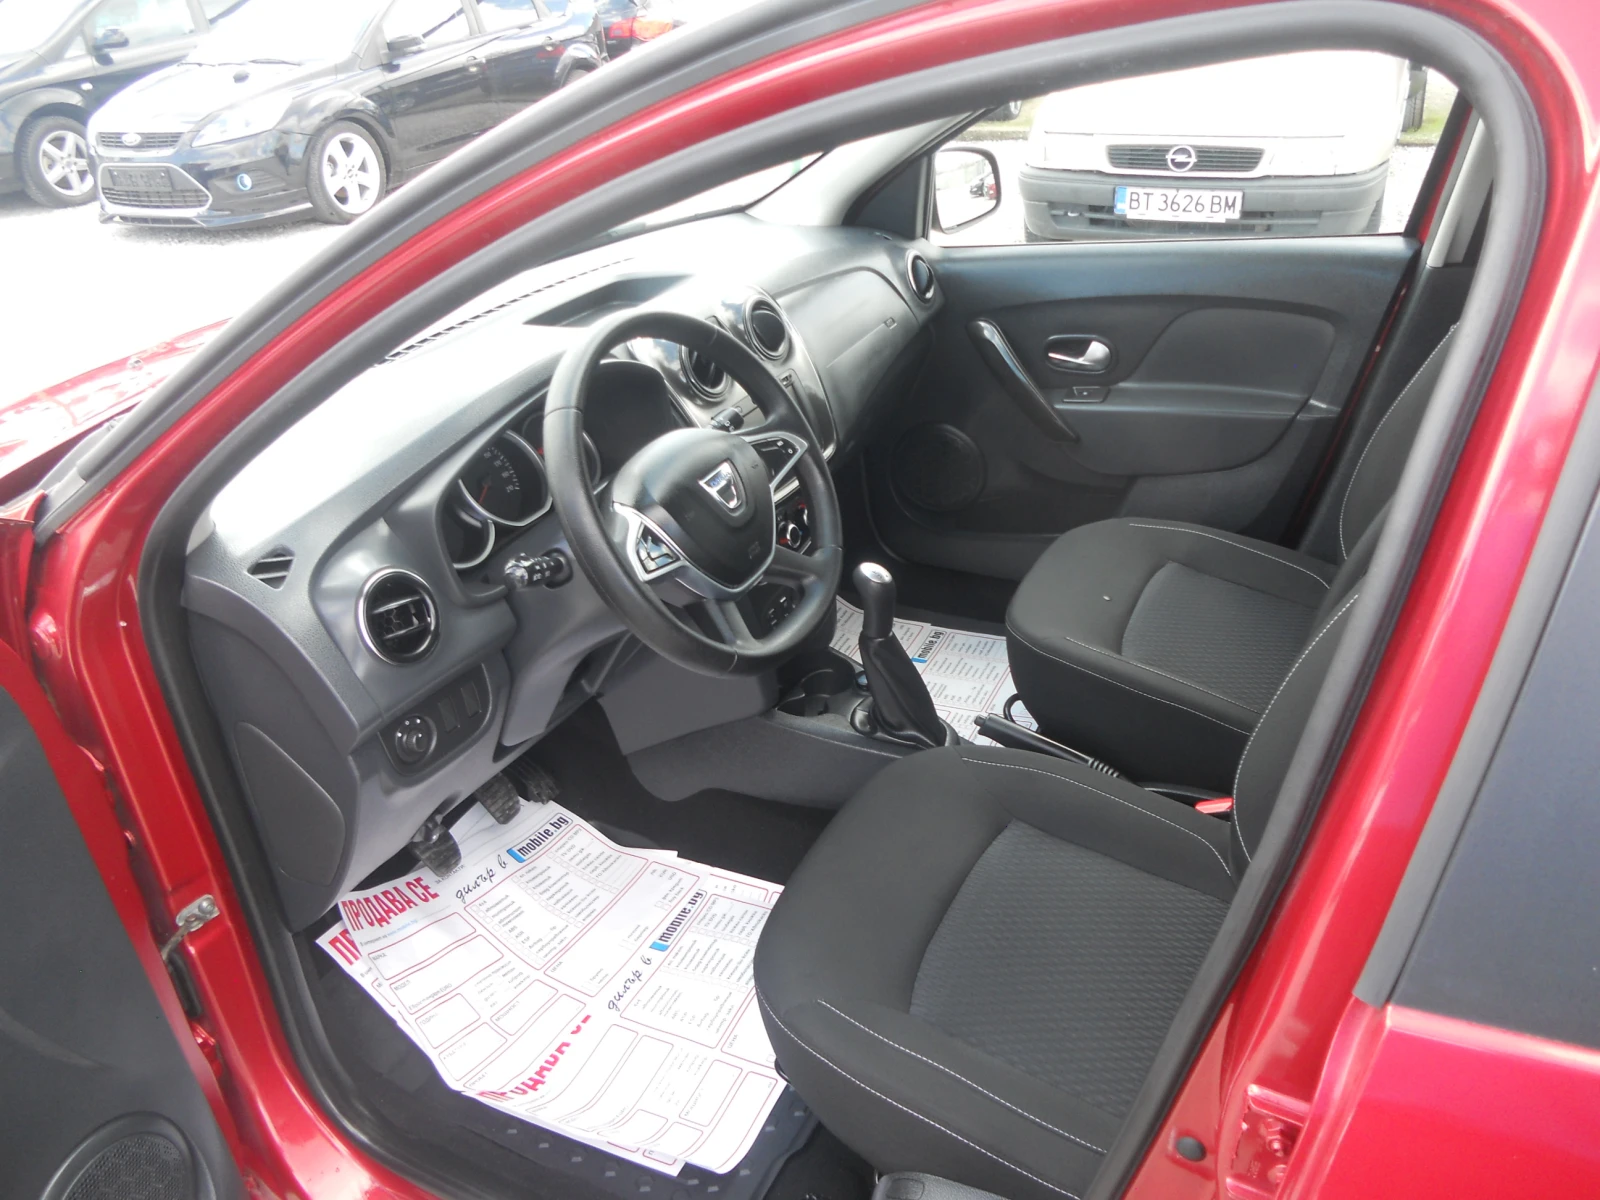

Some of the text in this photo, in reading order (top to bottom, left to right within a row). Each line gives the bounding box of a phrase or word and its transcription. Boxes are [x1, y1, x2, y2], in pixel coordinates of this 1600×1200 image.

[1129, 192, 1237, 214] BT 3626 BM
[518, 814, 569, 857] mobile.bg
[341, 877, 440, 931] ПРОДАВА СЕ
